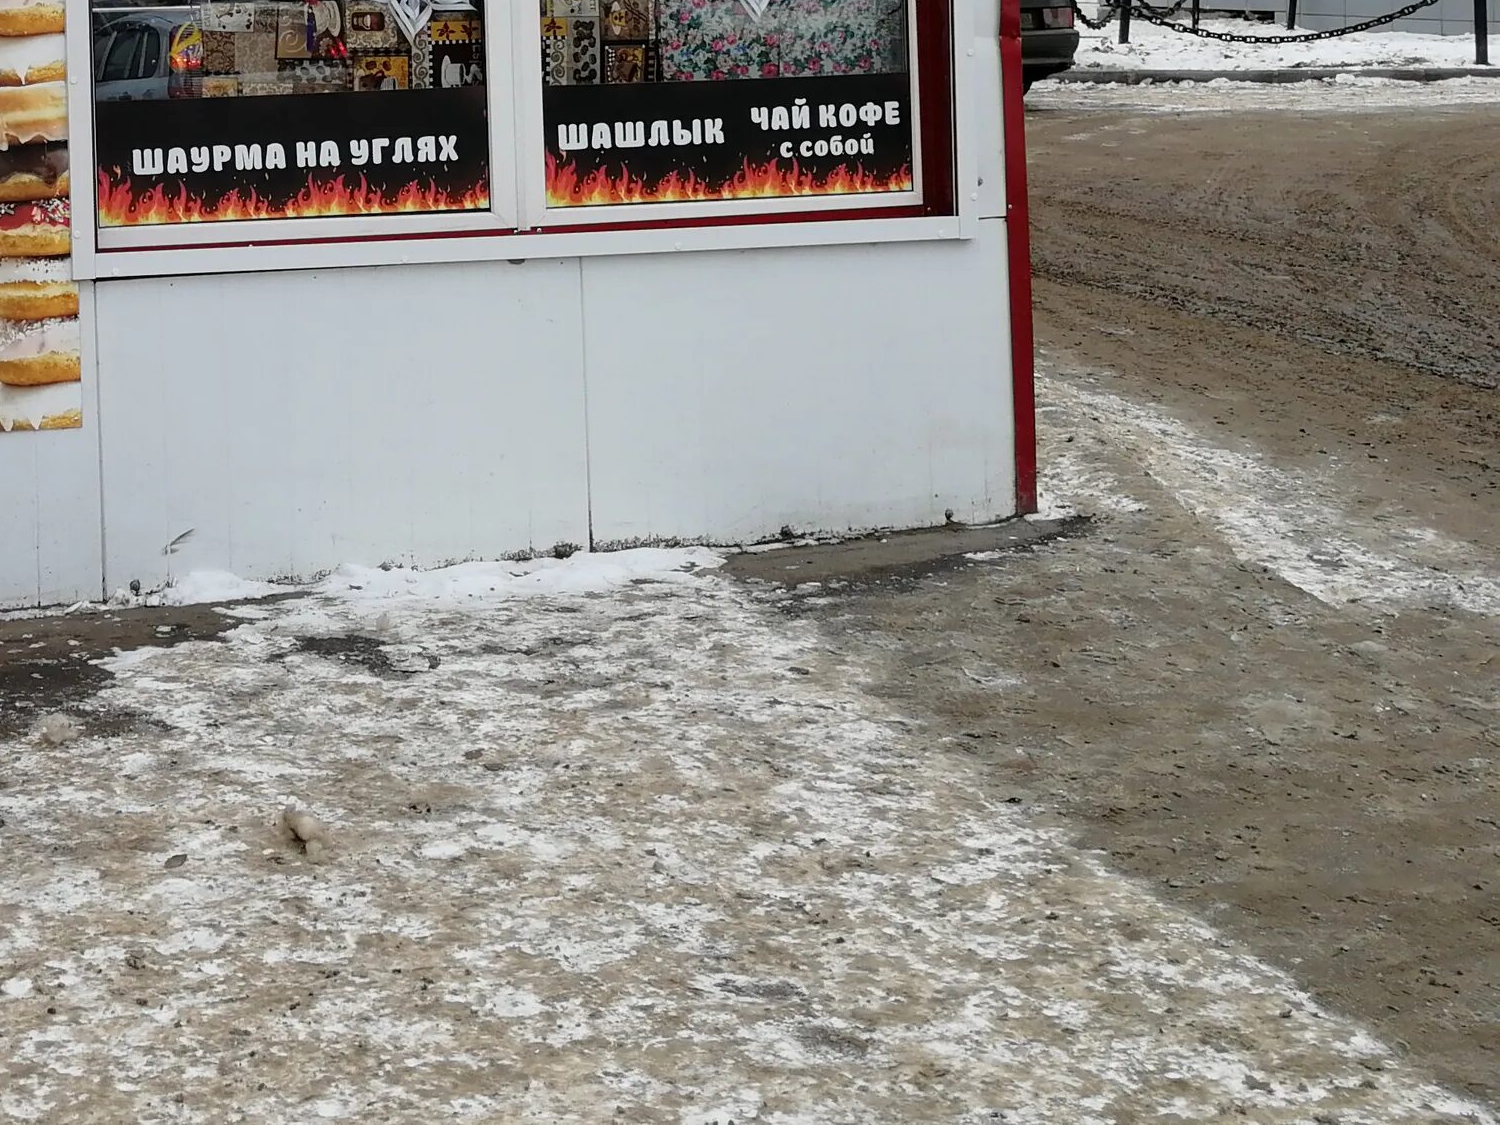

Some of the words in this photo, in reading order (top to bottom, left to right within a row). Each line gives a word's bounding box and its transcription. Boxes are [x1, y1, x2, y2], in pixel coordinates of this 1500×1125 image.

[750, 97, 811, 131] ЧАЙ
[818, 101, 901, 128] КОФЕ
[557, 117, 725, 151] ШАШЛЫК
[779, 141, 794, 158] с
[800, 132, 875, 157] собой
[132, 142, 287, 176] ШАУРМА
[295, 140, 342, 168] НА
[349, 135, 459, 166] УГЛЯХ
